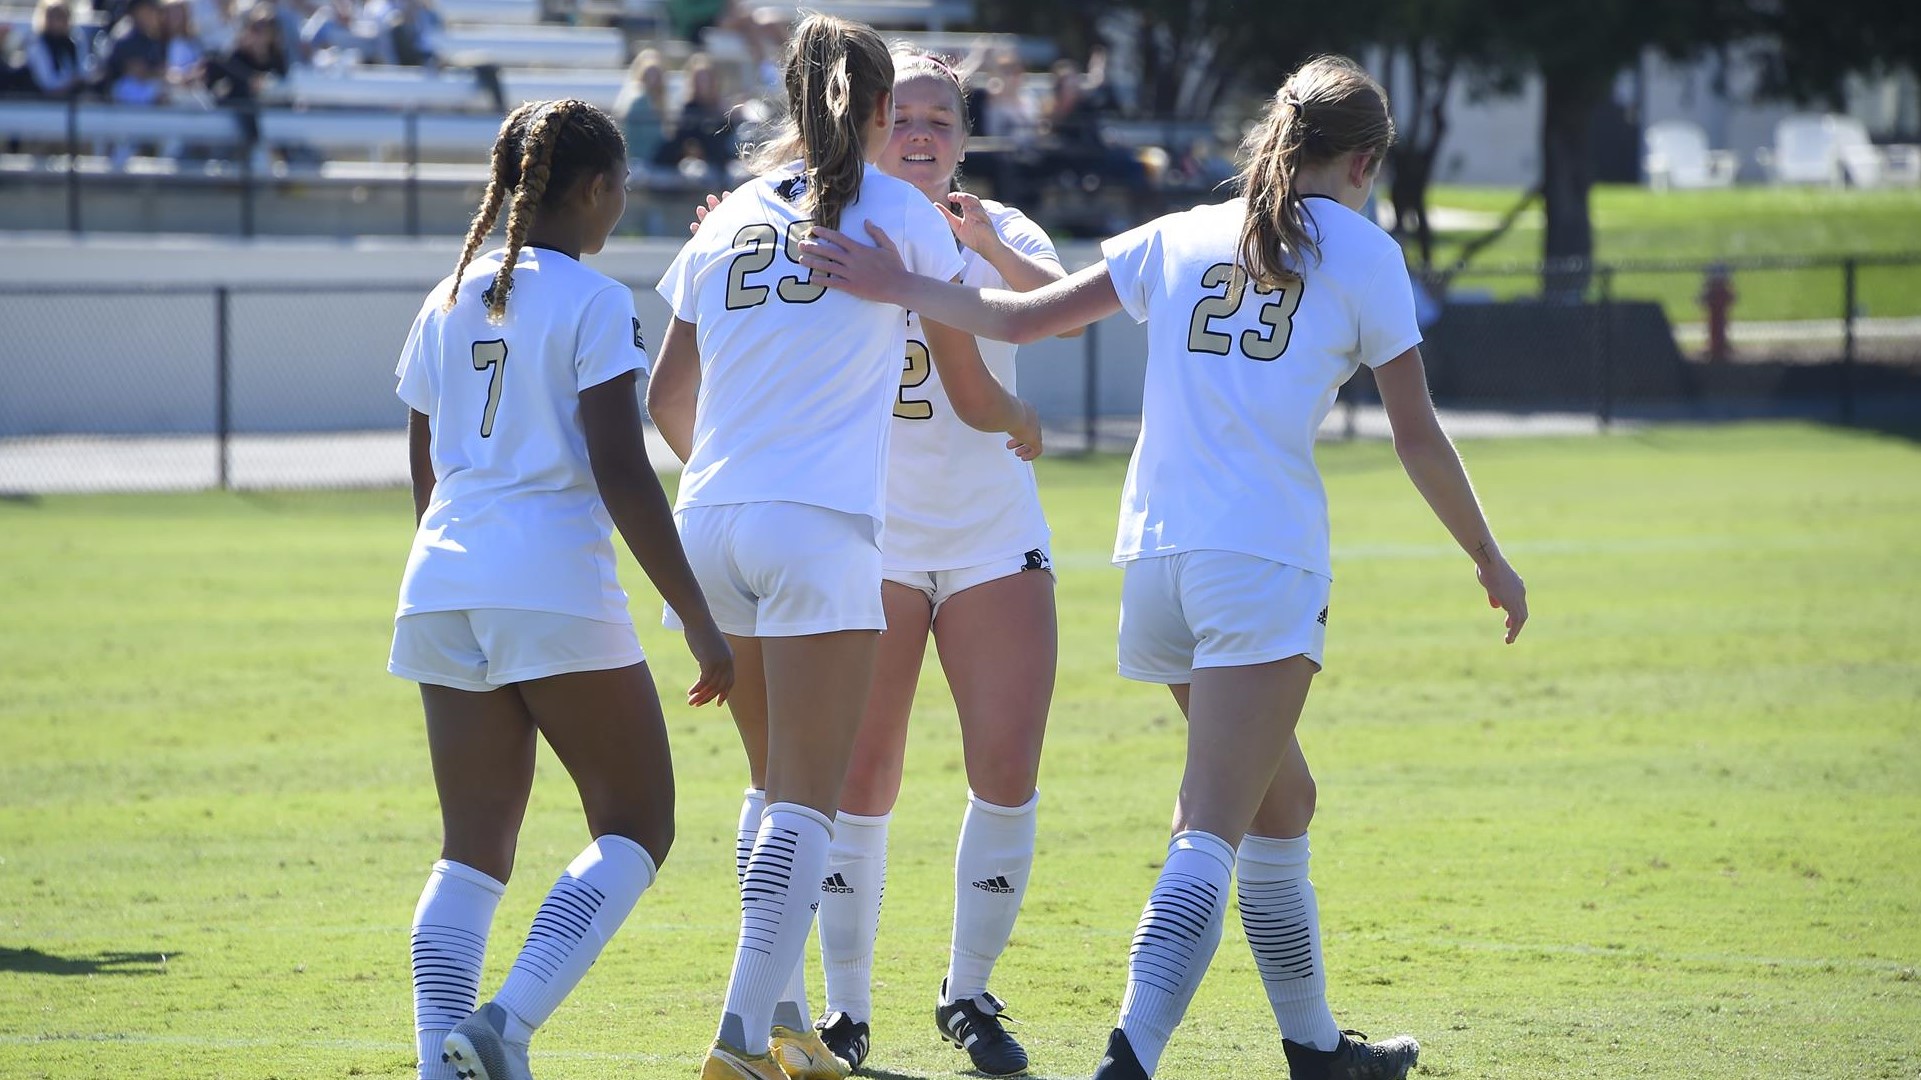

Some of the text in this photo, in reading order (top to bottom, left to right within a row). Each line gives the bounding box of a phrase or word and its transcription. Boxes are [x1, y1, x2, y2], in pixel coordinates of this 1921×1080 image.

[1187, 262, 1305, 361] 23
[471, 338, 509, 438] 7
[821, 881, 855, 894] didas
[972, 880, 1015, 894] adidas
